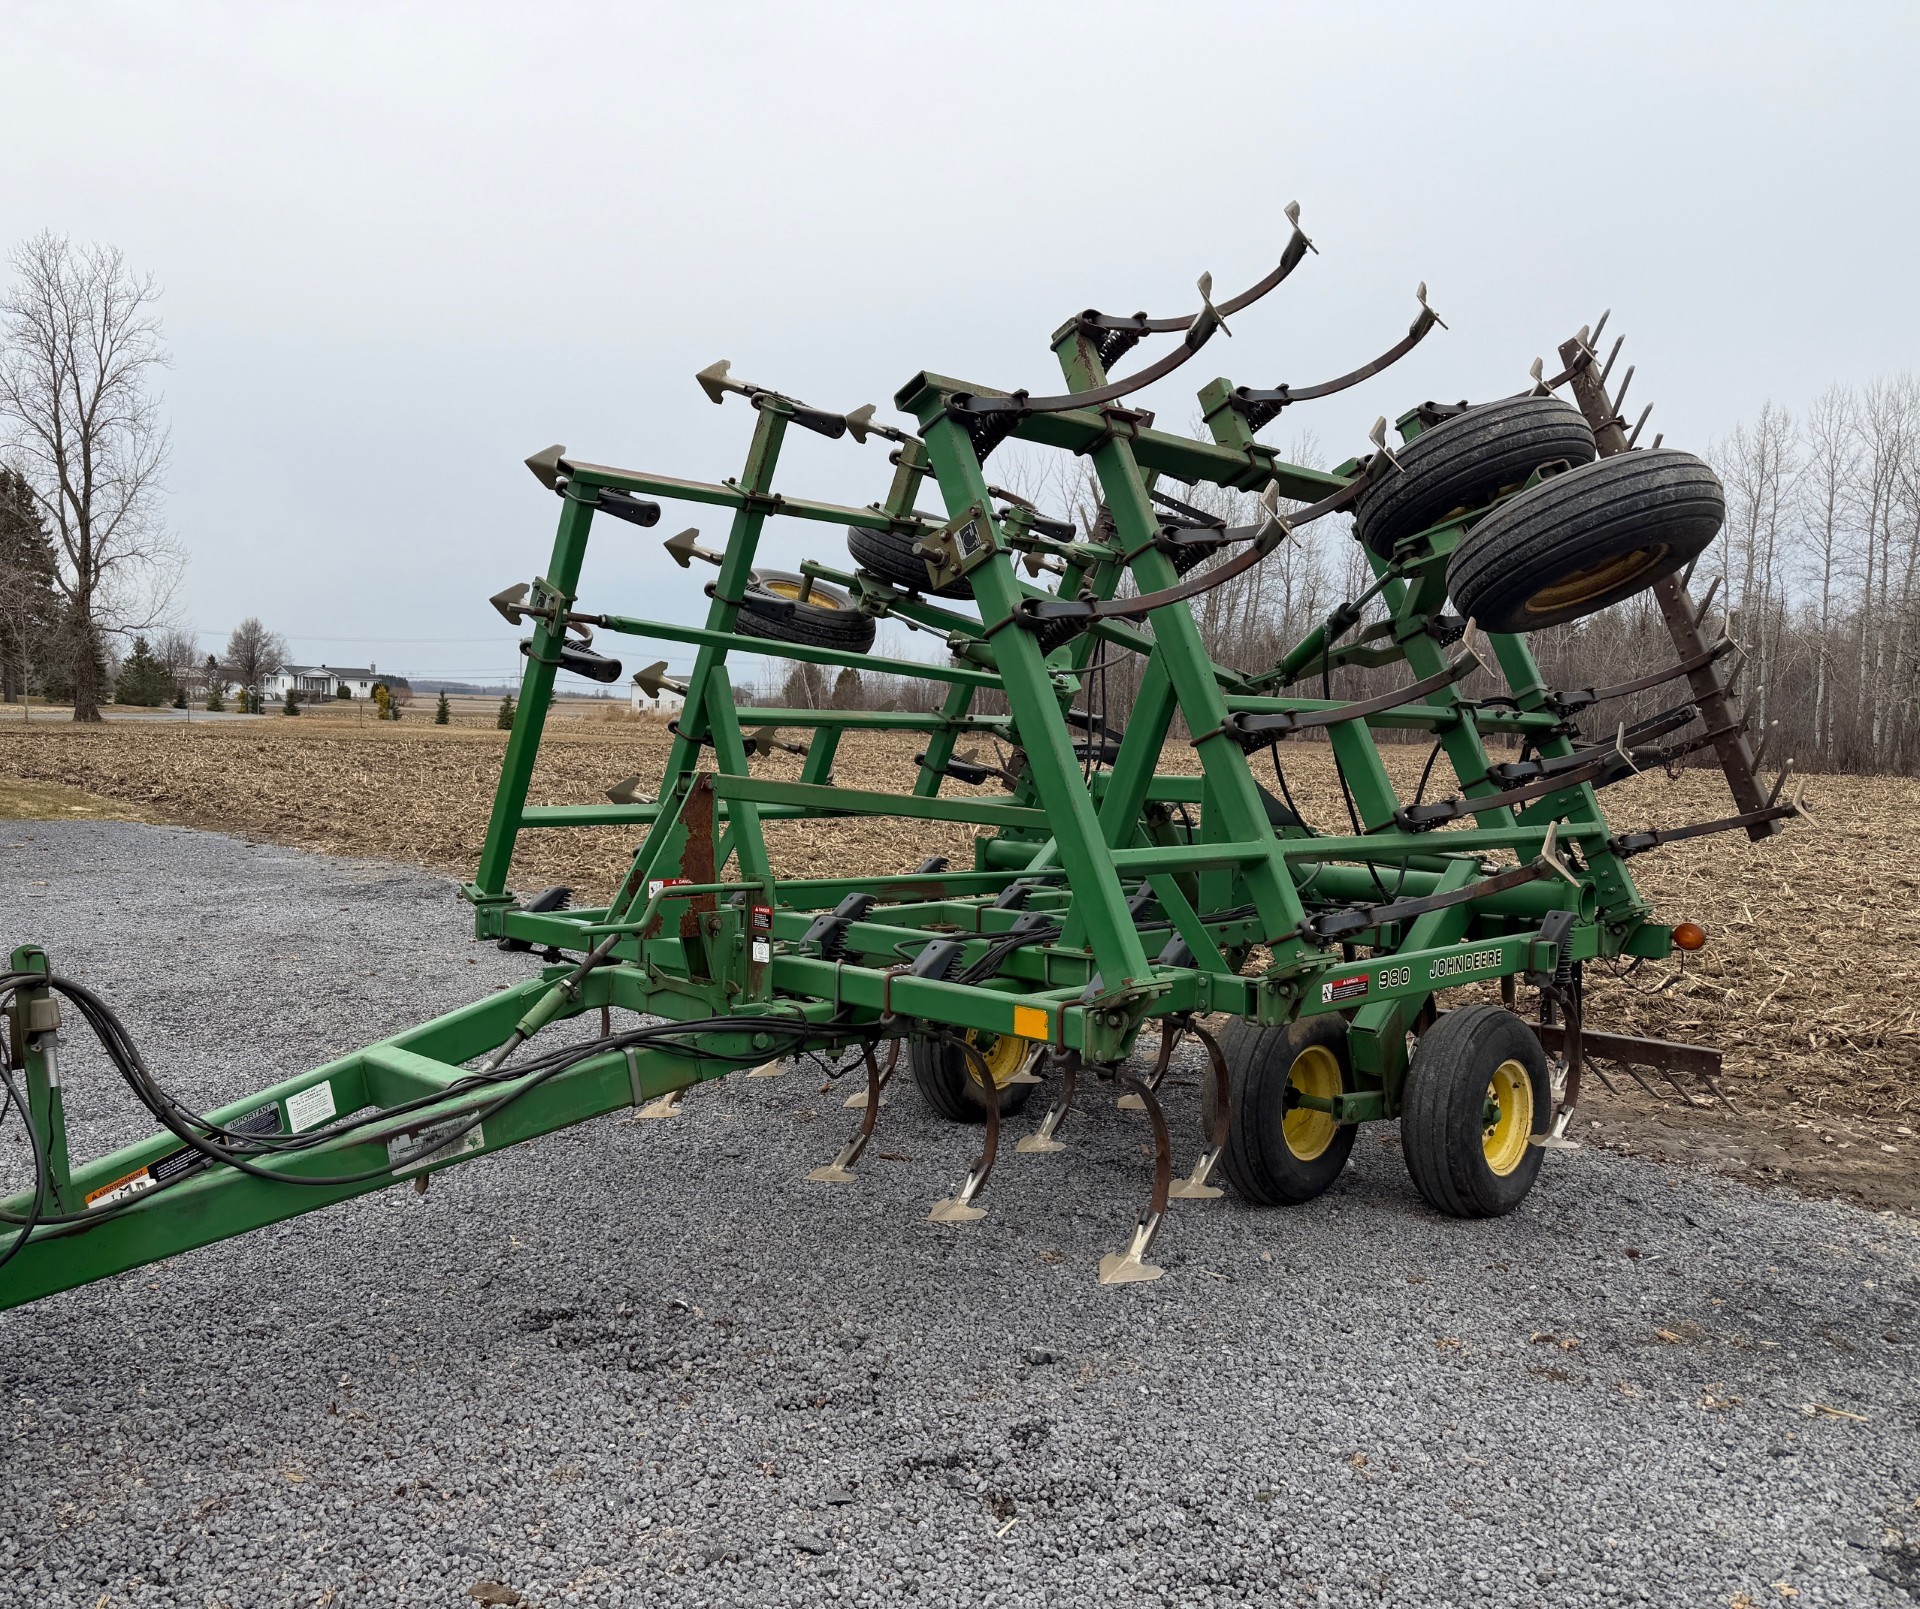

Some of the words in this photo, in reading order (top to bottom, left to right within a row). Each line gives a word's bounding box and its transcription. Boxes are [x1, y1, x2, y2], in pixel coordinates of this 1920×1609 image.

[1429, 955, 1464, 979] JOHN
[1464, 949, 1502, 972] DEERE
[1379, 966, 1411, 990] 980
[230, 1103, 272, 1128] IMPORTANT
[99, 1170, 144, 1196] AVERTISSEMENT
